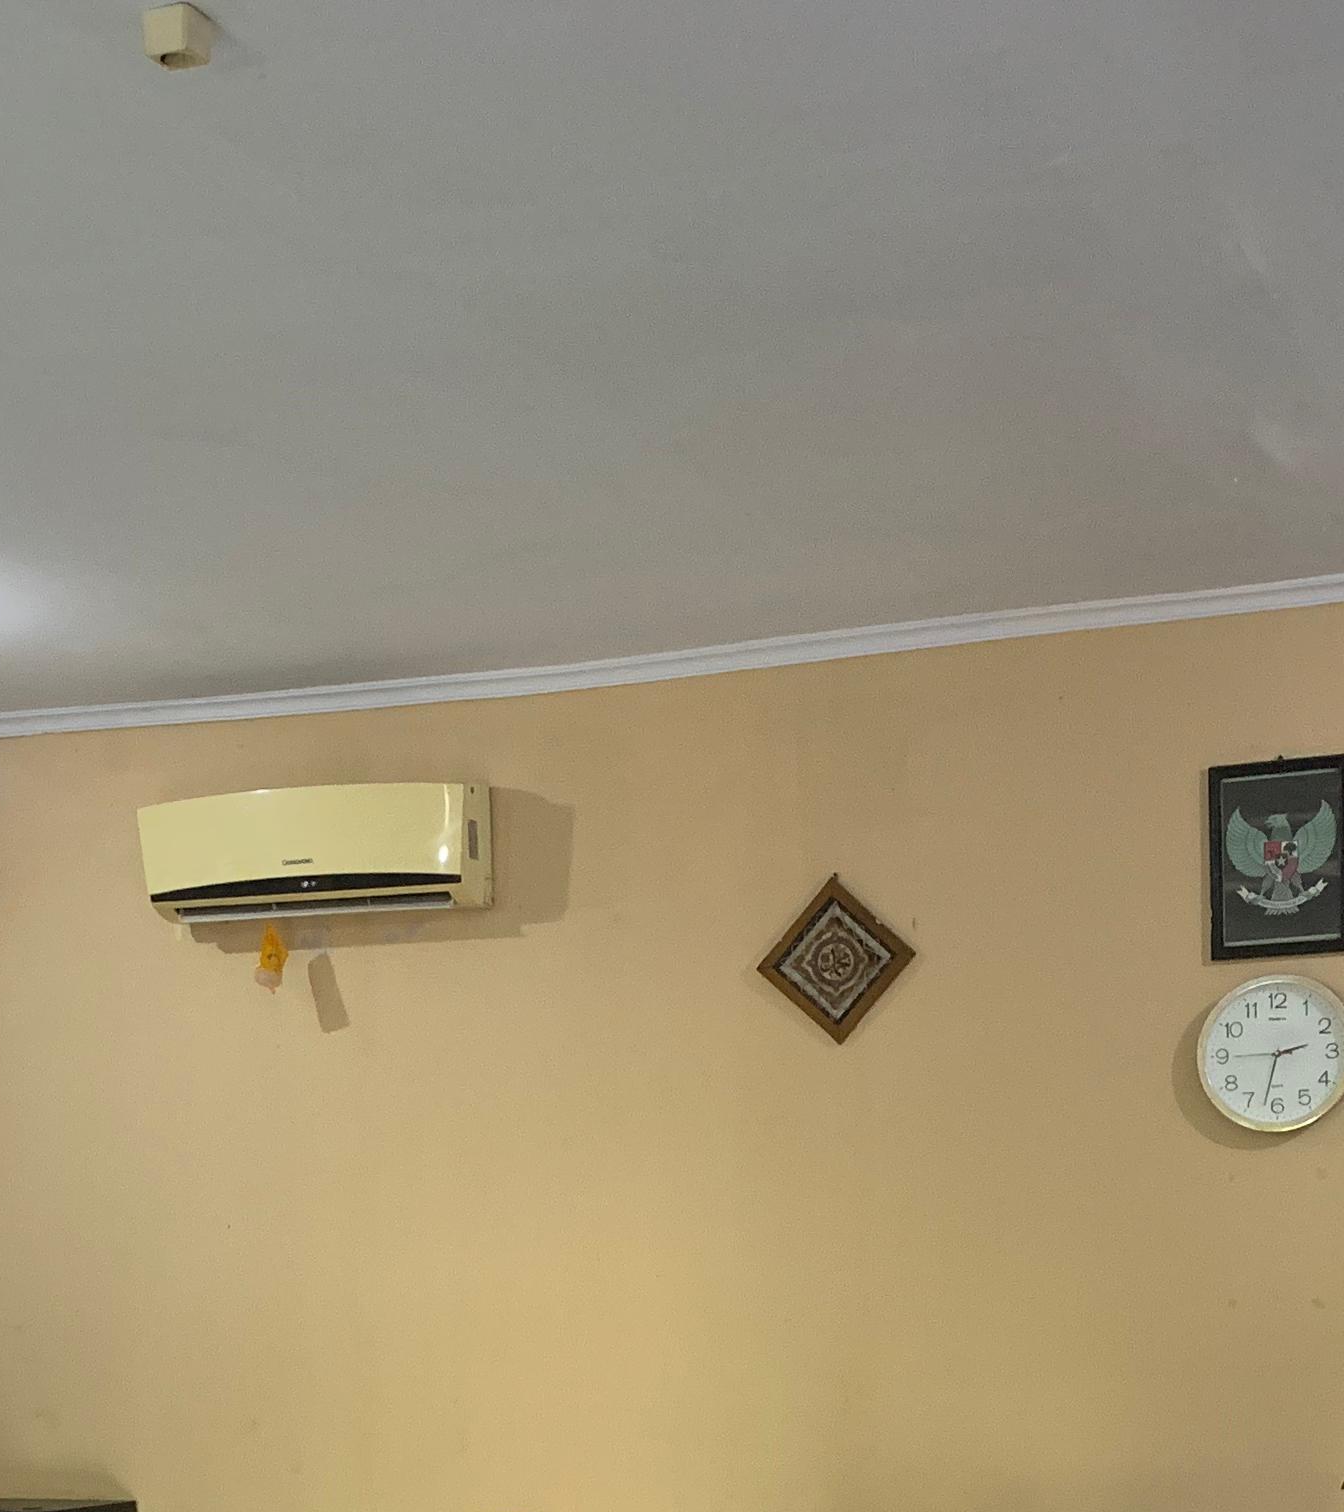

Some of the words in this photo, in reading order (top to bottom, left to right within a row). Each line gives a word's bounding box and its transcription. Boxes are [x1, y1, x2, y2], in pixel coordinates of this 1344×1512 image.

[1268, 992, 1287, 1009] 12
[1302, 999, 1309, 1016] 1
[1245, 1002, 1257, 1018] 11
[1224, 1021, 1243, 1038] 10
[1318, 1017, 1332, 1034] 2
[1215, 1048, 1229, 1065] 9
[1325, 1042, 1340, 1059] 3
[1224, 1074, 1238, 1091] 8
[1318, 1070, 1331, 1087] 4
[1242, 1091, 1255, 1108] 7
[1270, 1097, 1285, 1114] 6
[1298, 1089, 1312, 1106] 5
